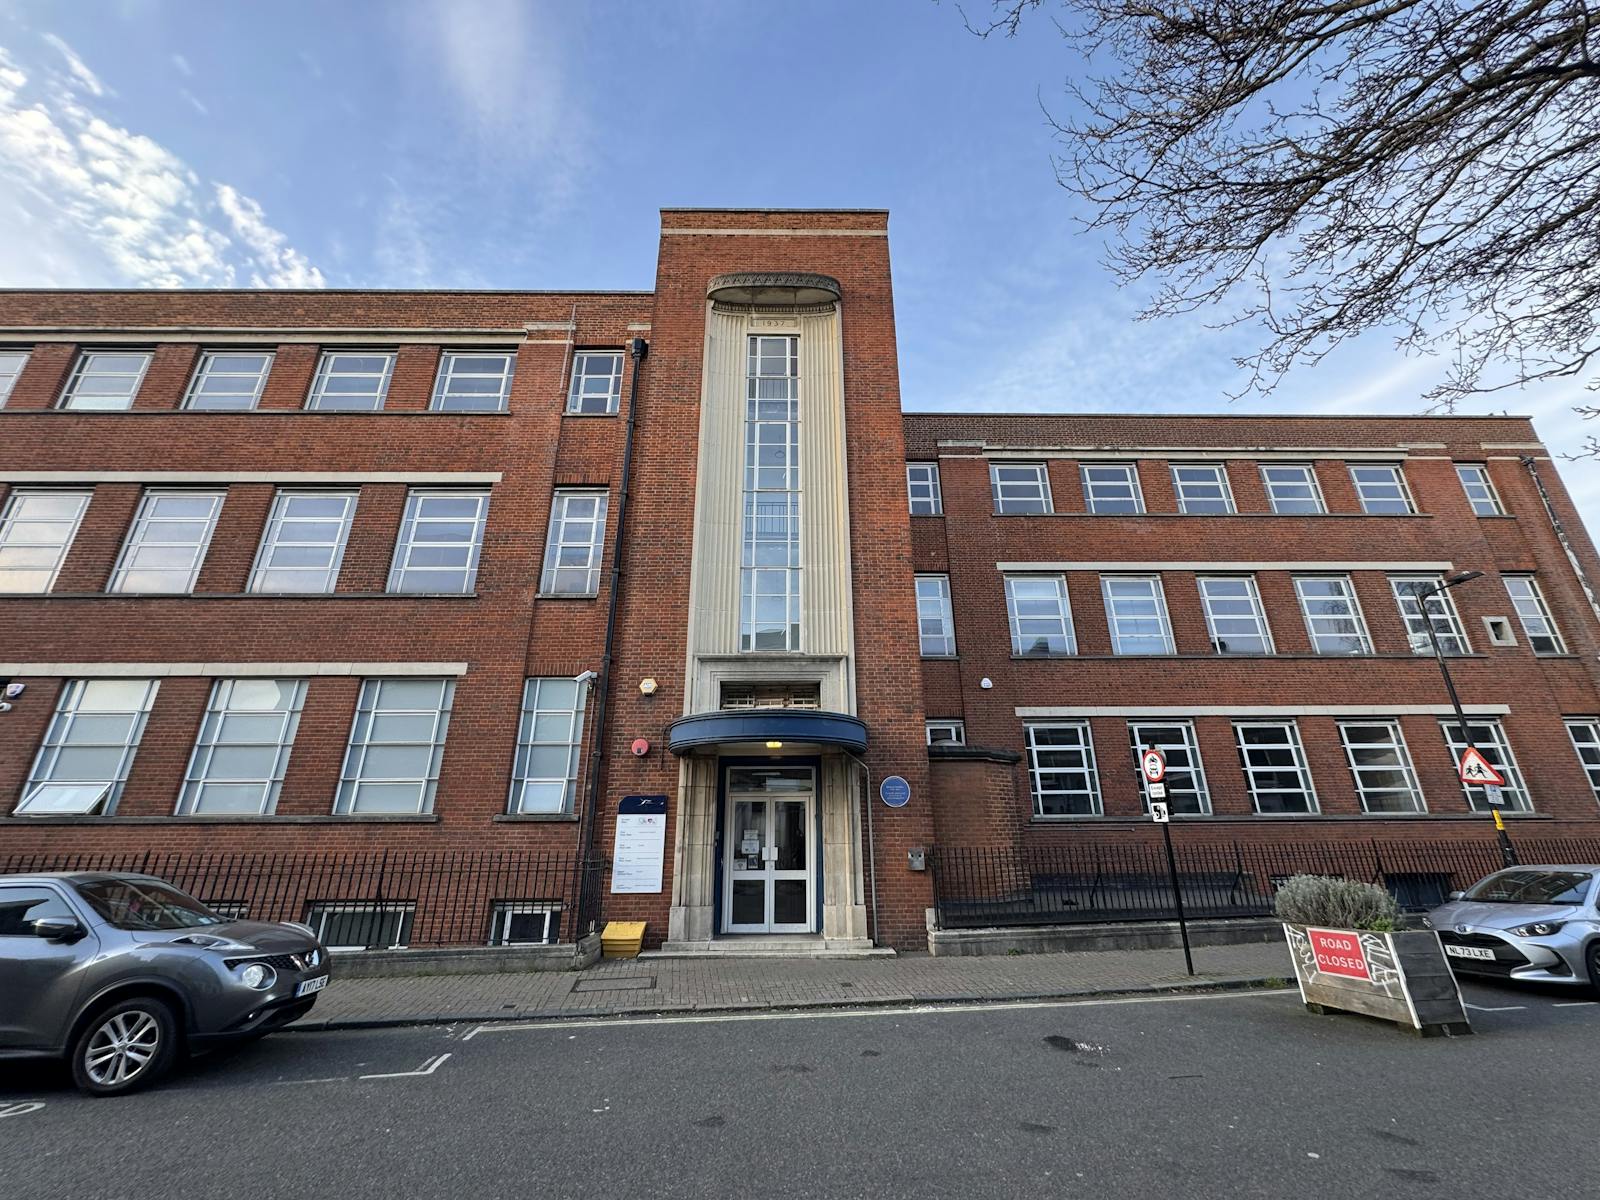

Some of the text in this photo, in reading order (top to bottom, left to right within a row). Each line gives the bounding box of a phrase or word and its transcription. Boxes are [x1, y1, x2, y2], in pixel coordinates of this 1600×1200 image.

[1319, 937, 1352, 951] ROAD
[1449, 946, 1491, 958] NL73 LXE
[1317, 954, 1364, 970] CLOSED
